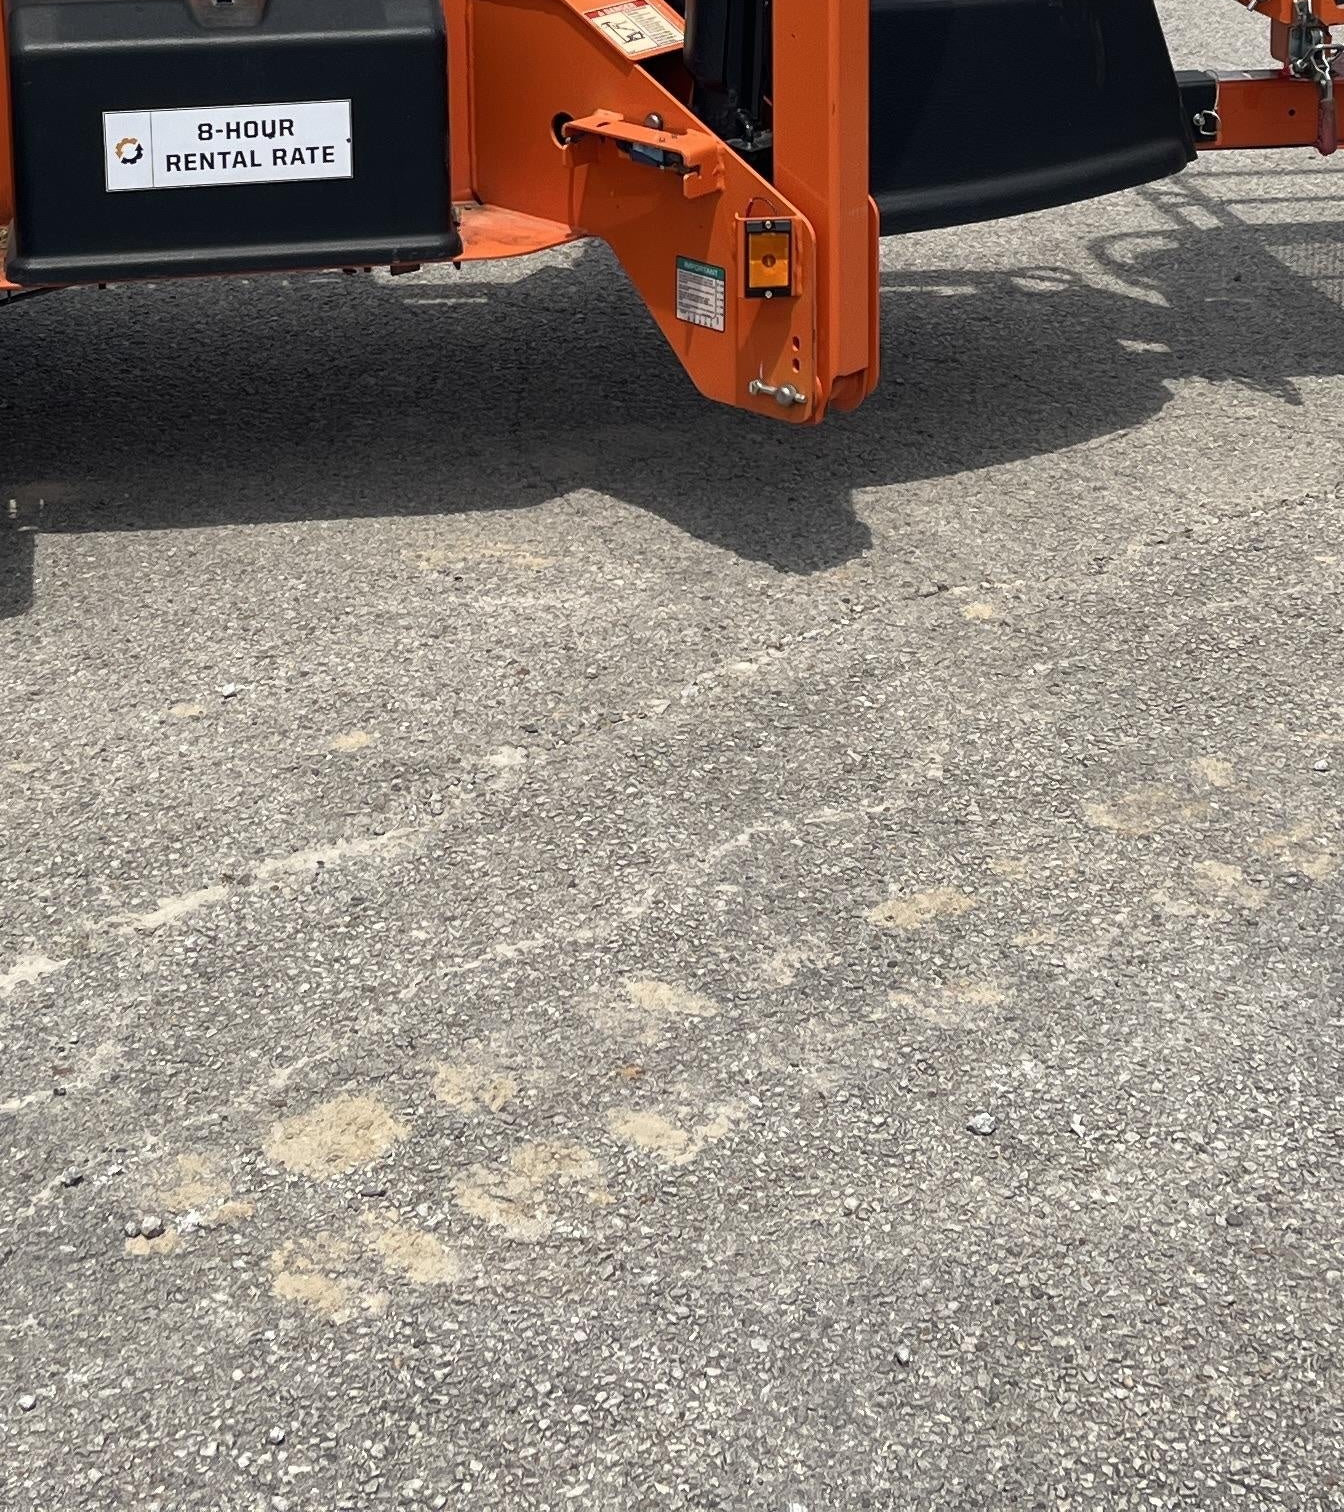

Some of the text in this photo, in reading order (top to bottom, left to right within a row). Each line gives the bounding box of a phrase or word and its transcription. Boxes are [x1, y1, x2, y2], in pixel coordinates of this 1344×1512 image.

[198, 118, 295, 141] 8-HOUR
[166, 145, 336, 172] RENTAL RATE
